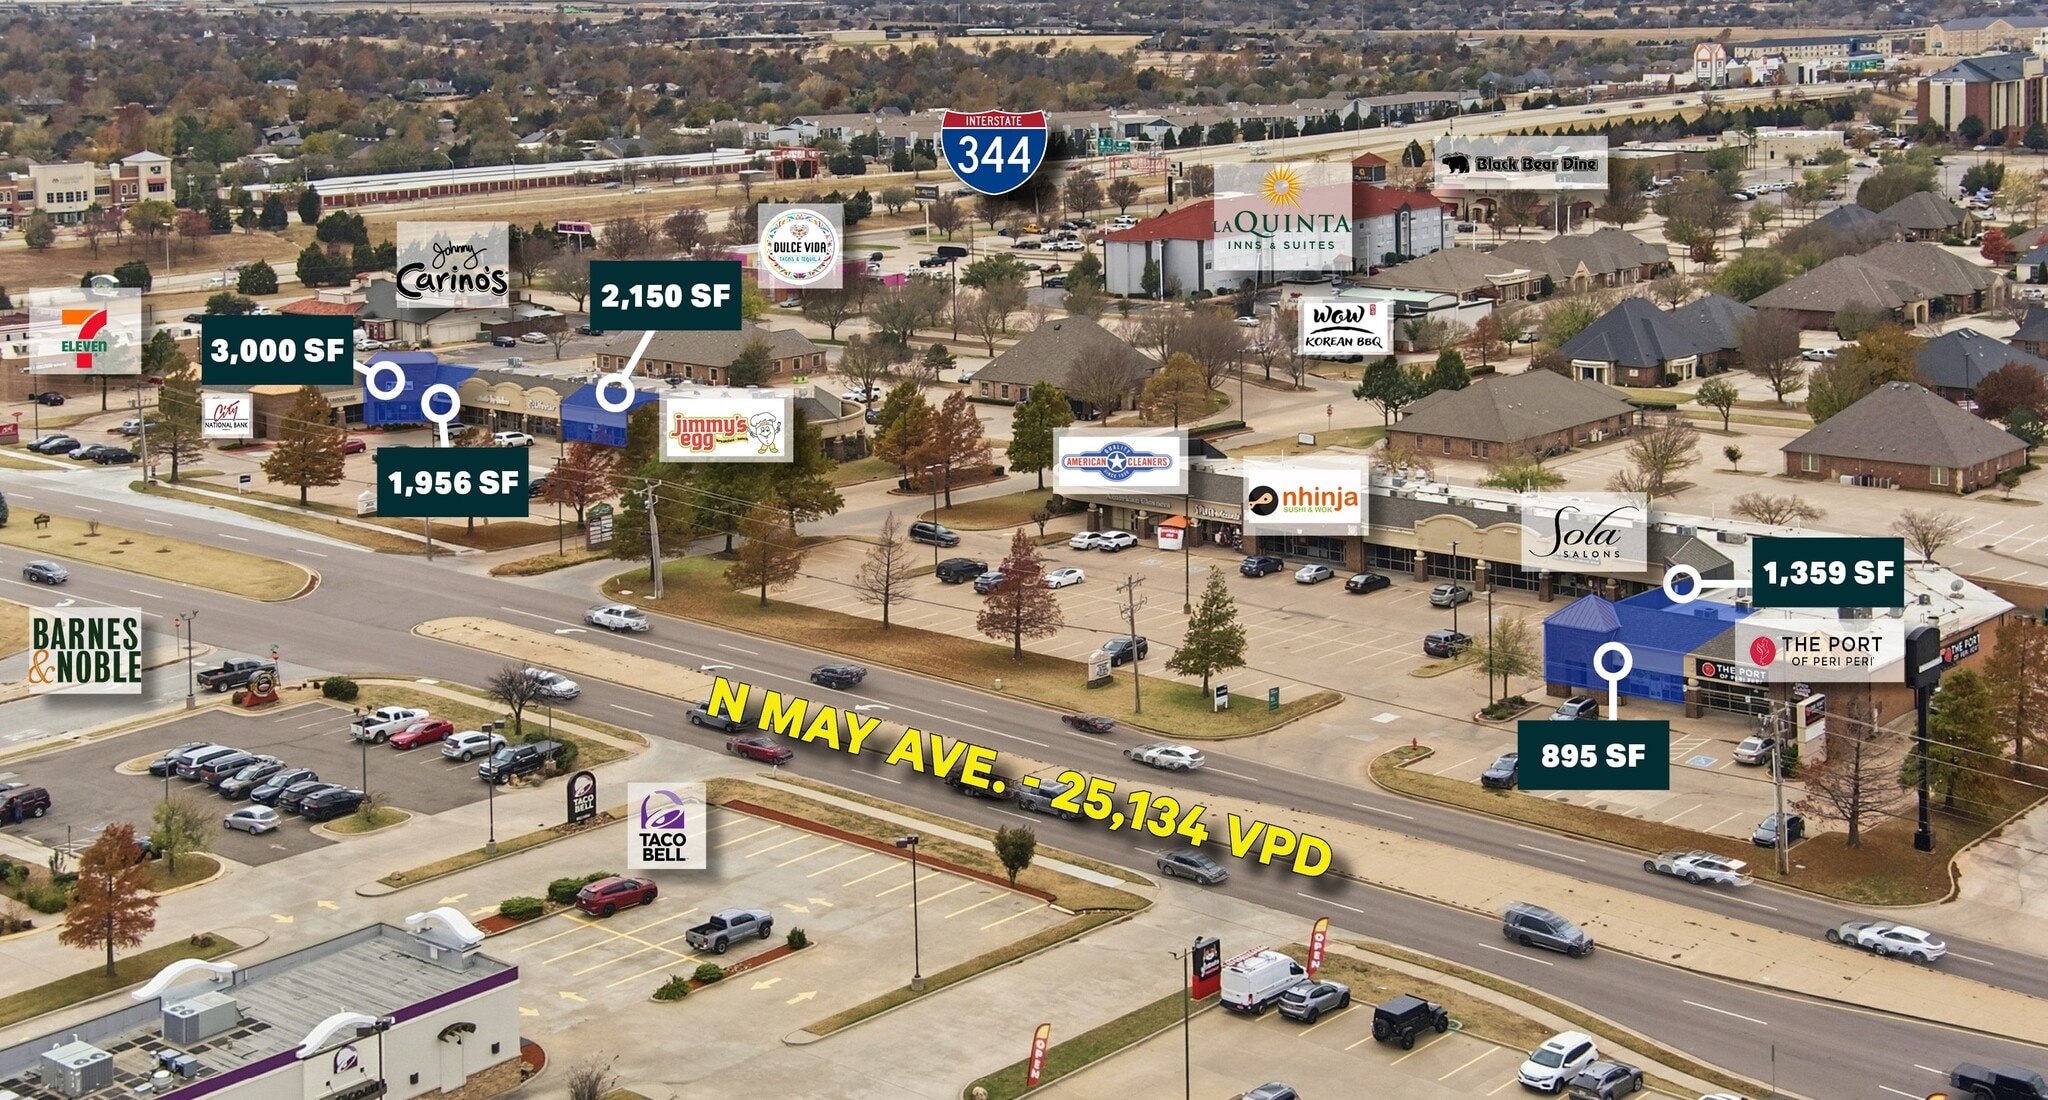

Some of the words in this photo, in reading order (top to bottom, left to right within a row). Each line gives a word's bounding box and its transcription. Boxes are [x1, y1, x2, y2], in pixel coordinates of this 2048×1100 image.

[1717, 664, 1736, 674] THE
[1739, 668, 1766, 679] PORT
[573, 794, 594, 806] TACO
[575, 802, 594, 813] BELL
[1311, 933, 1324, 969] OPEN
[1030, 1040, 1045, 1079] OPEN
